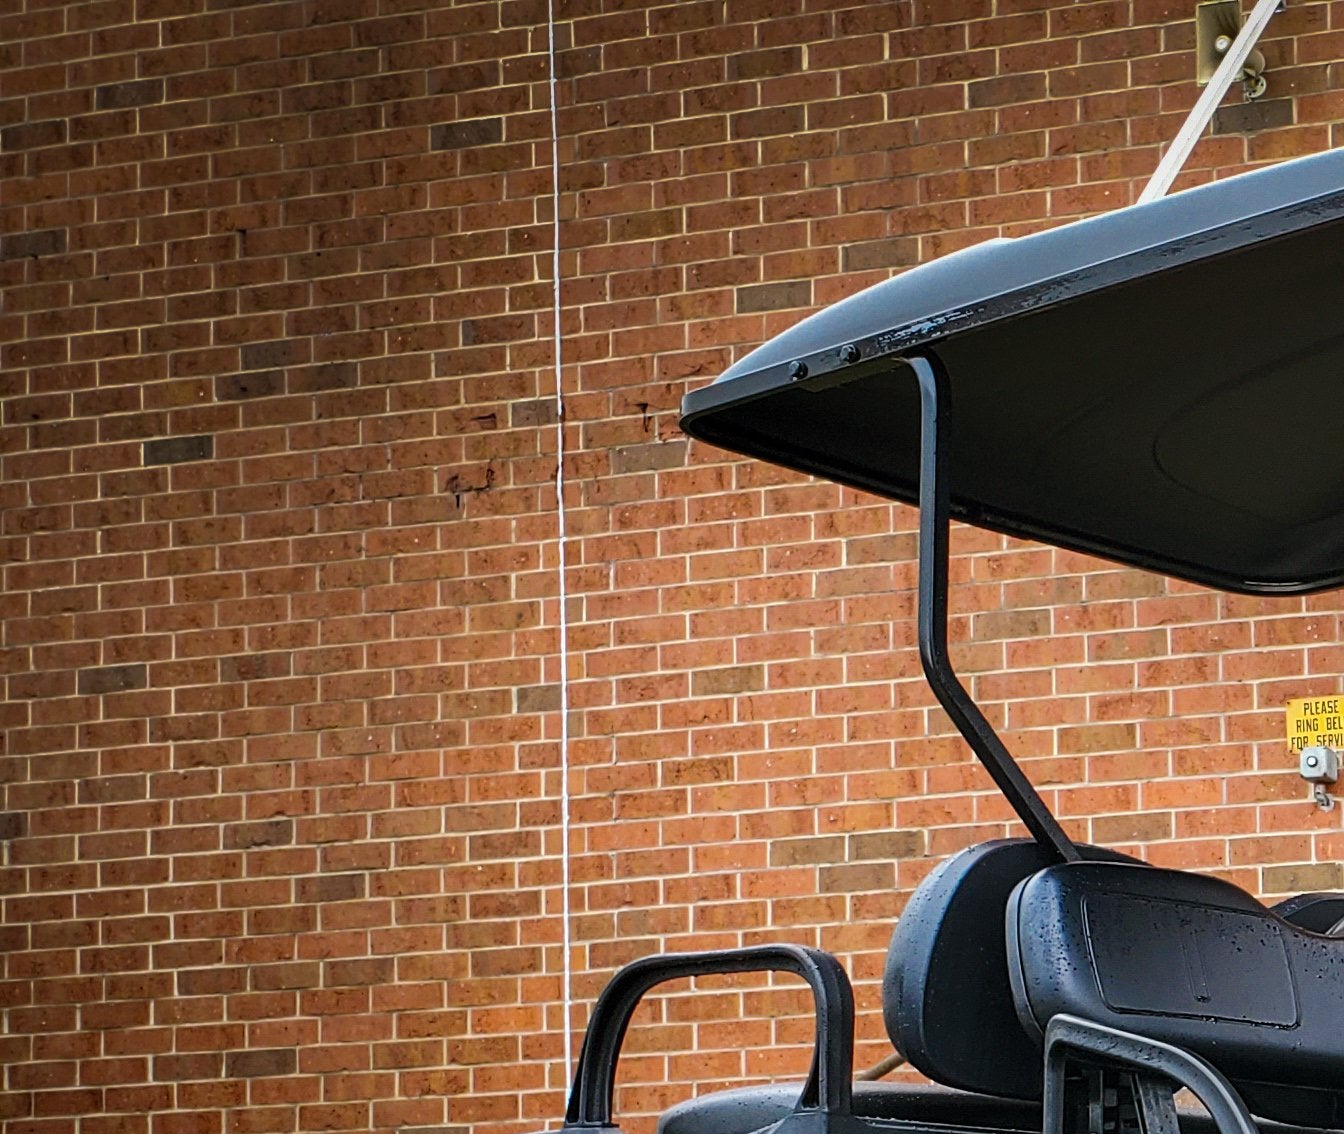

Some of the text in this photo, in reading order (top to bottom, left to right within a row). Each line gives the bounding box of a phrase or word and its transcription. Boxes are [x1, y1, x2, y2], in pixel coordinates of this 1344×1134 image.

[1303, 700, 1339, 716] PLEASE
[1296, 718, 1319, 733] RING
[1291, 735, 1309, 750] FOR
